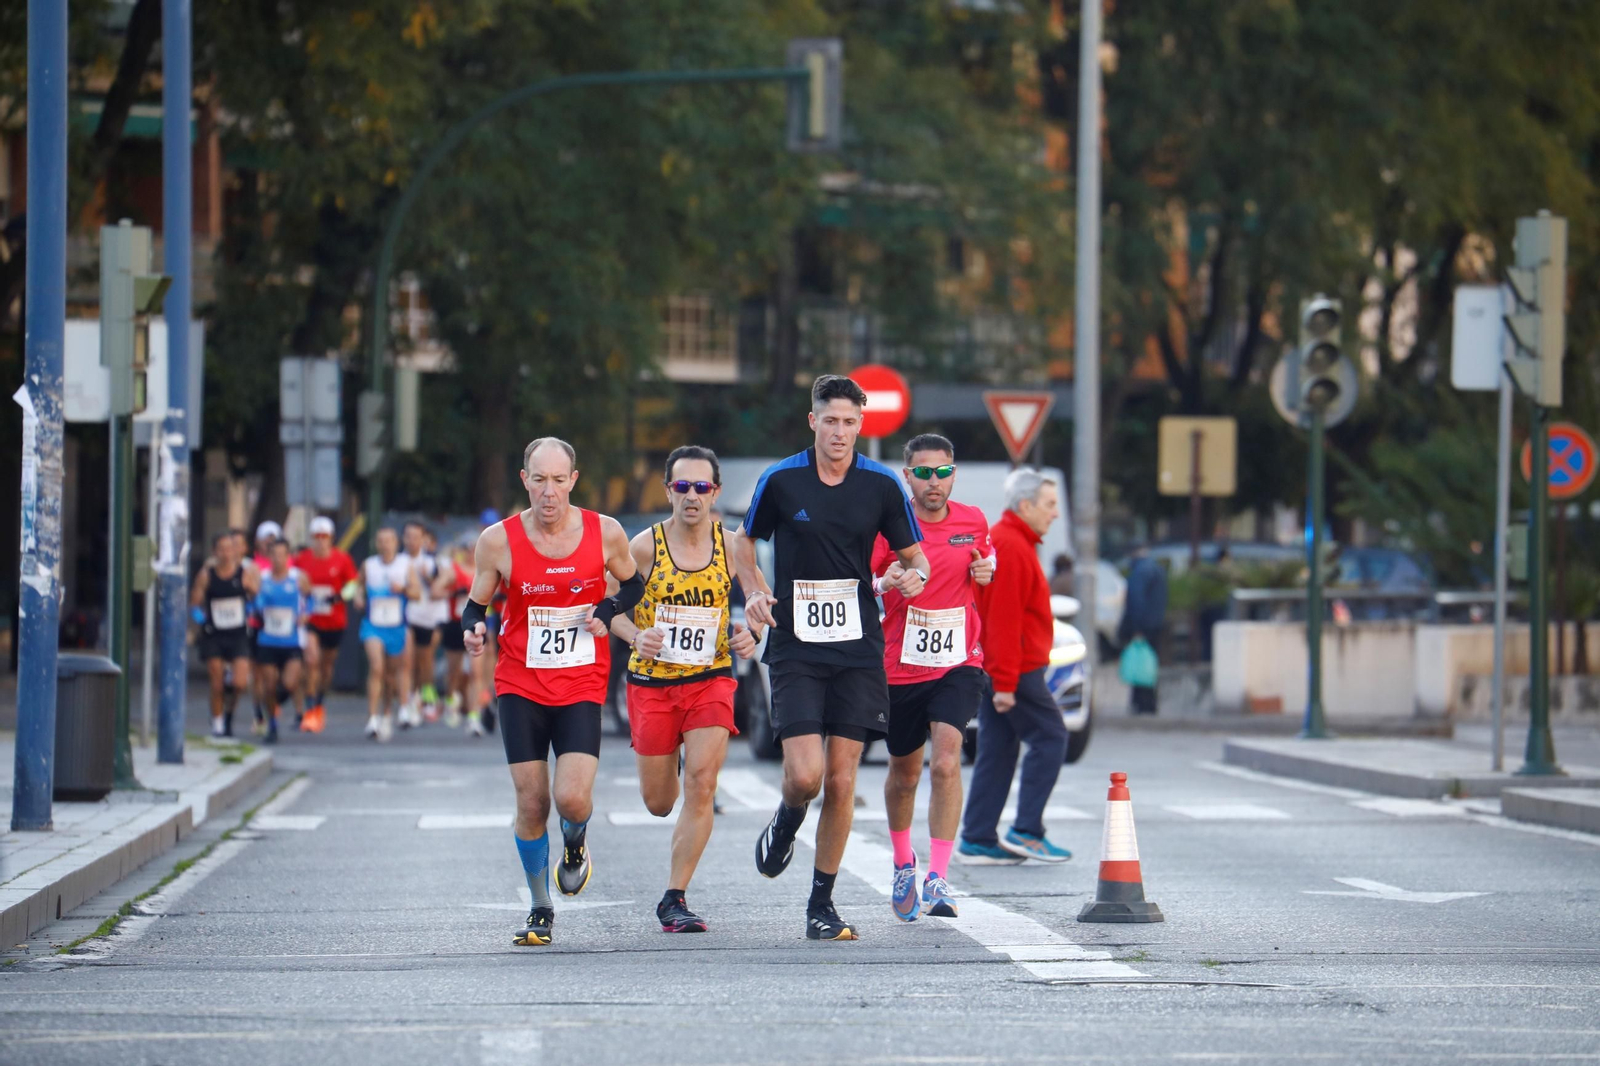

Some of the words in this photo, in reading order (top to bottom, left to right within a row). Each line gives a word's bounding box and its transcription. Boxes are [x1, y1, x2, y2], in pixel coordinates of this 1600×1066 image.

[528, 583, 555, 593] califas
[796, 583, 815, 600] XLI
[531, 609, 550, 627] XLI
[807, 601, 846, 627] 809
[909, 607, 928, 626] XLI
[540, 627, 578, 654] 257
[668, 626, 706, 652] 186
[916, 628, 953, 654] 384
